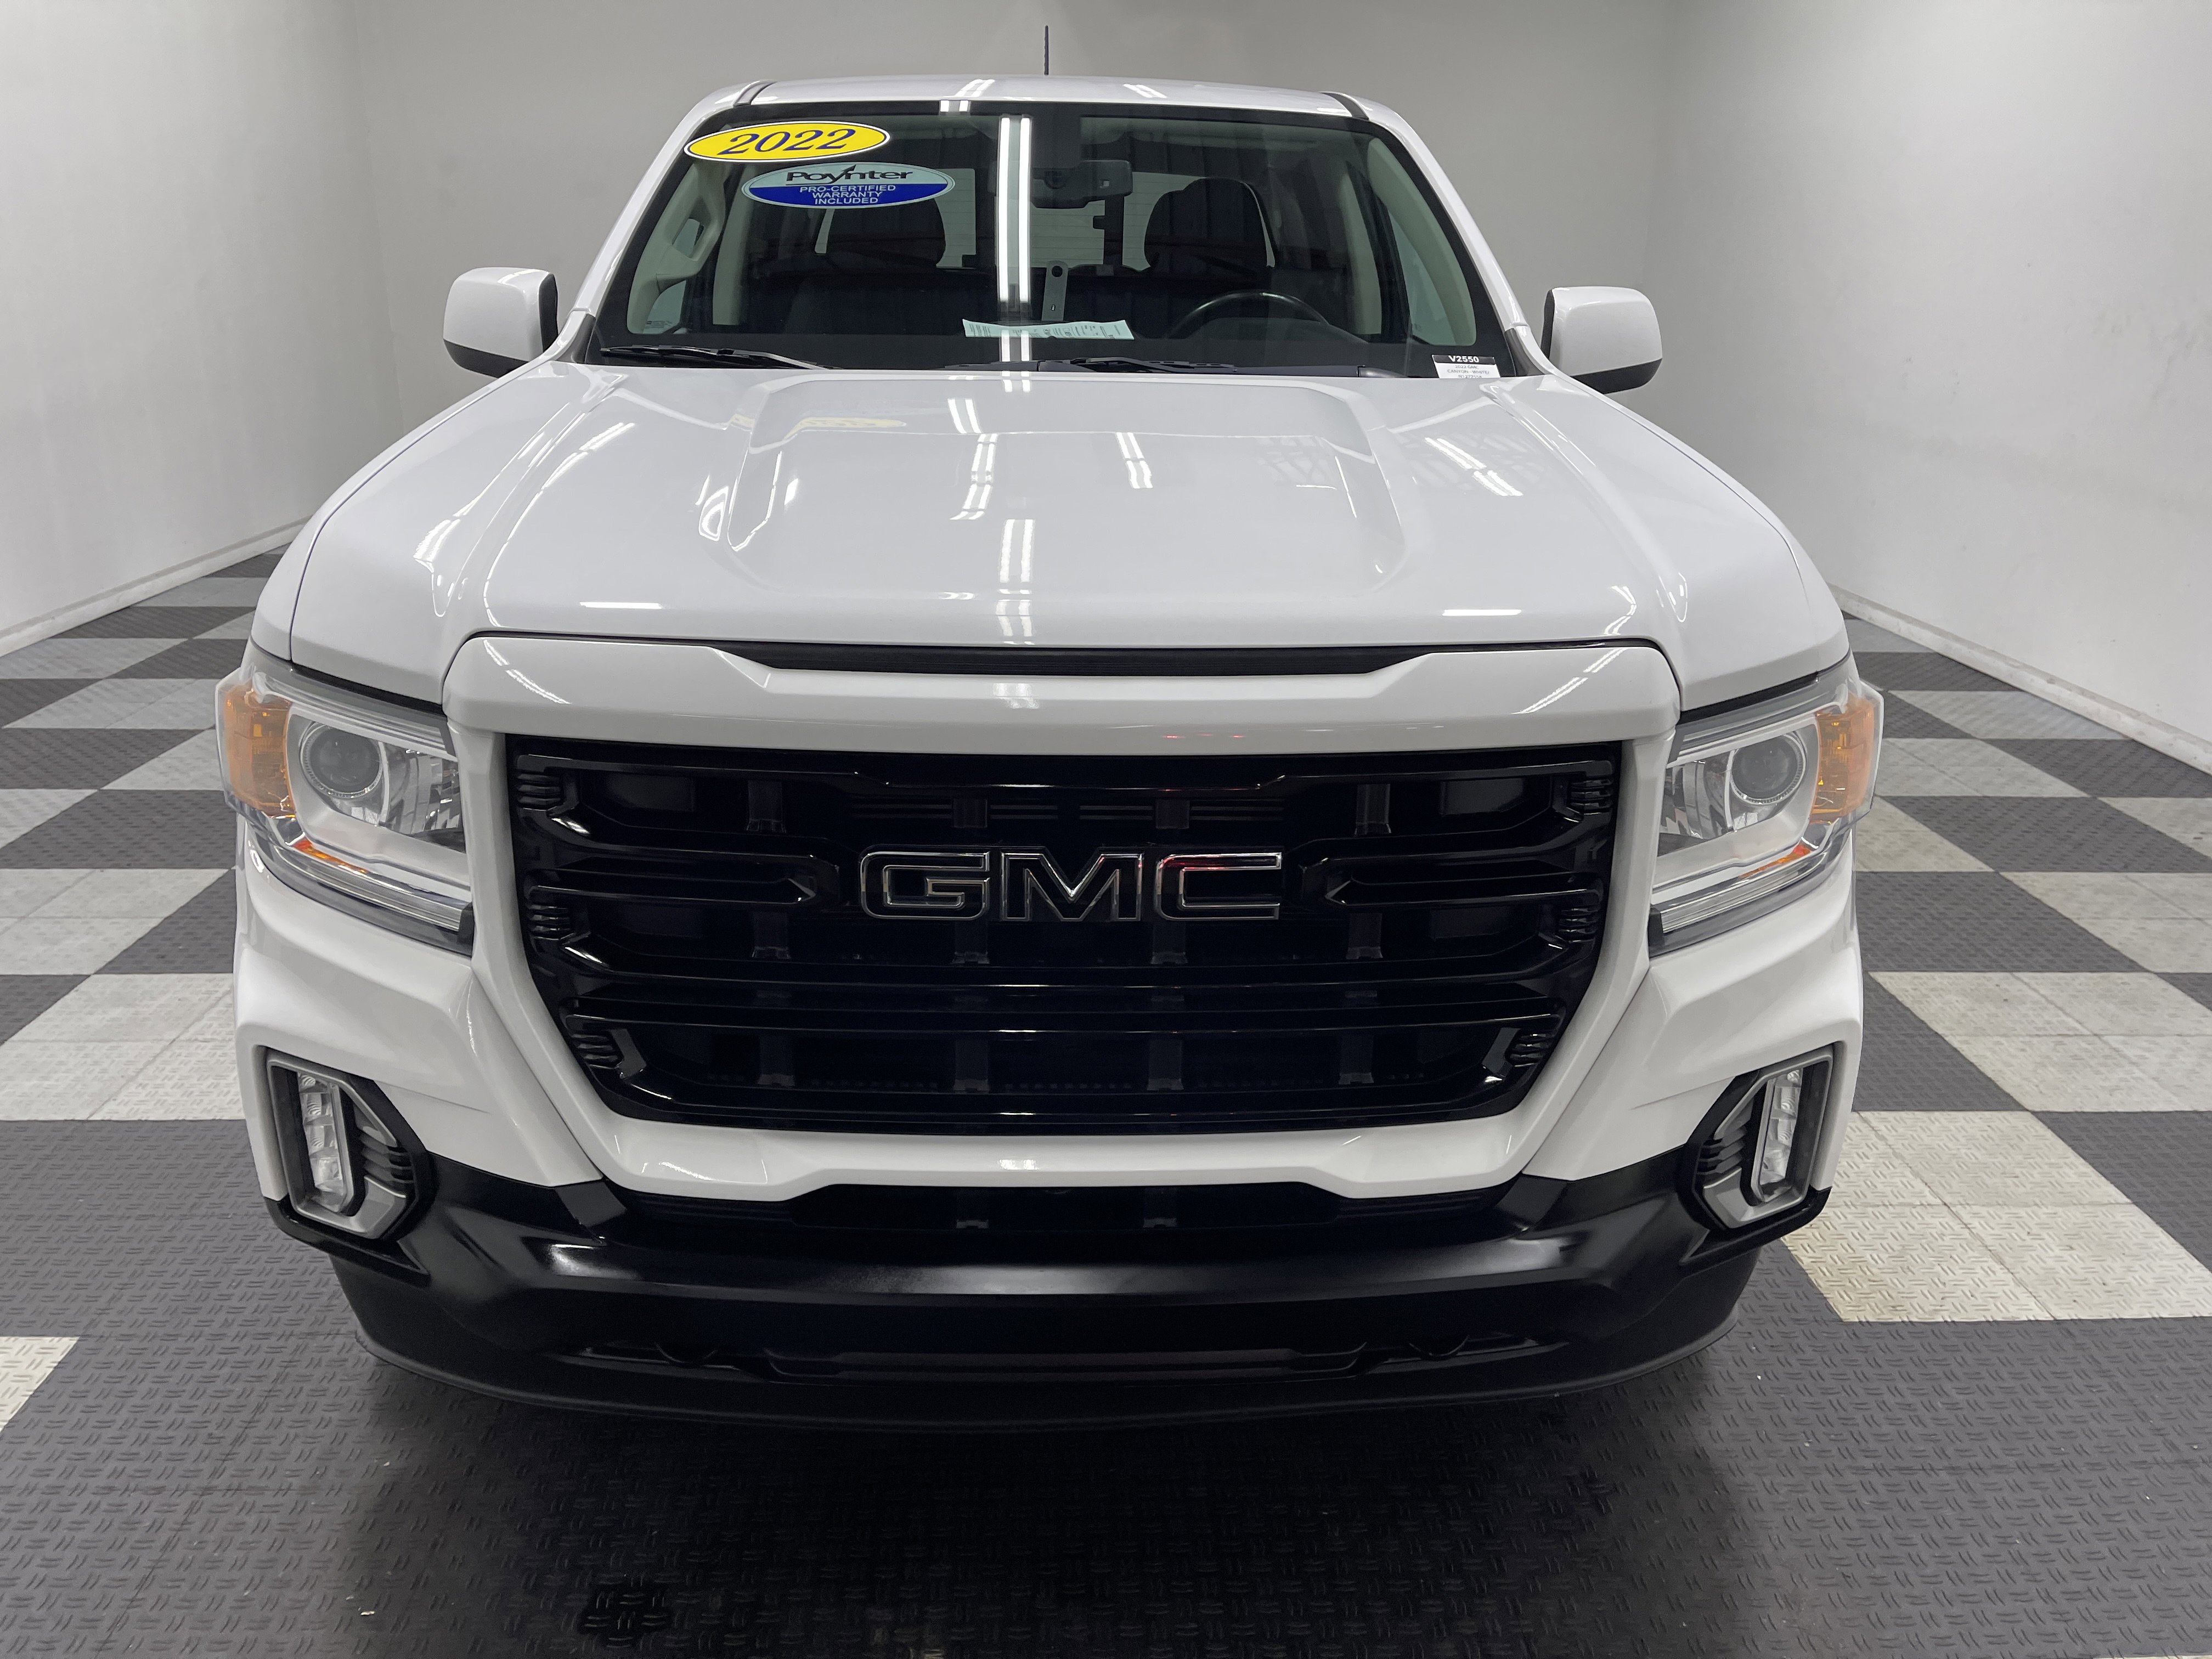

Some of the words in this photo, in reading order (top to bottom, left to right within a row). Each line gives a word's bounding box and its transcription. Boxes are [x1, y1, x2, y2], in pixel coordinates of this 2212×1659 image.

[716, 128, 856, 155] 2022
[786, 165, 913, 185] Poynter
[860, 850, 1282, 922] GMC
